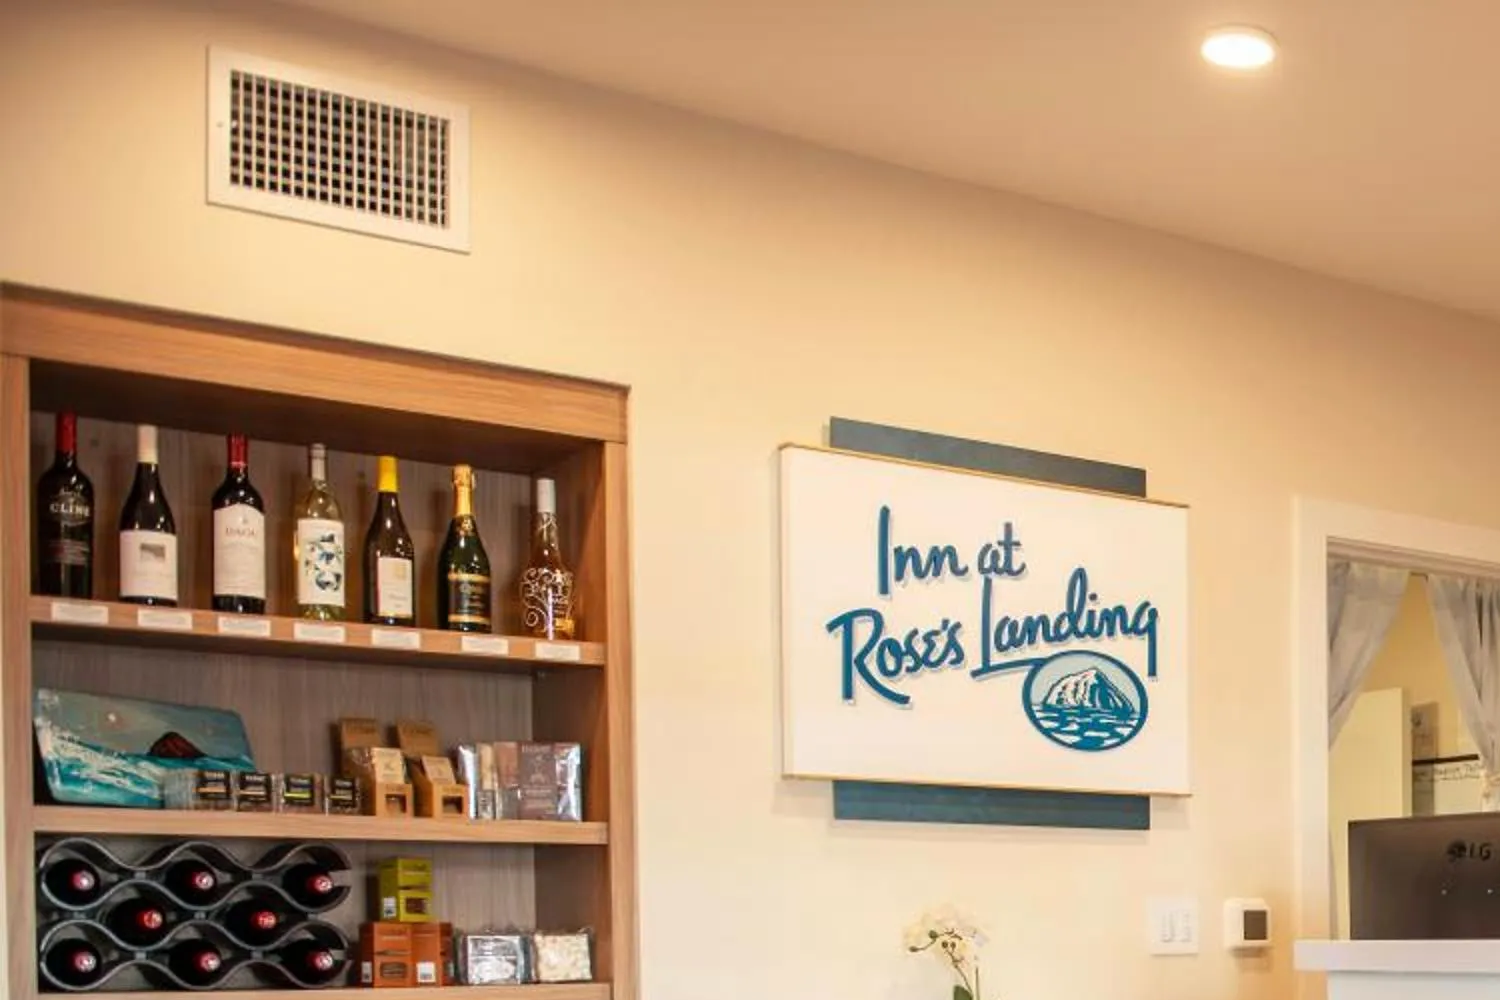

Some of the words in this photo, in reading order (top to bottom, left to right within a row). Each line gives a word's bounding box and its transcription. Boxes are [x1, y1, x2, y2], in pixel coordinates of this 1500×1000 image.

[877, 505, 968, 595] Inn
[977, 521, 1026, 577] at
[825, 607, 966, 705] Rose's
[970, 567, 1158, 678] Landing
